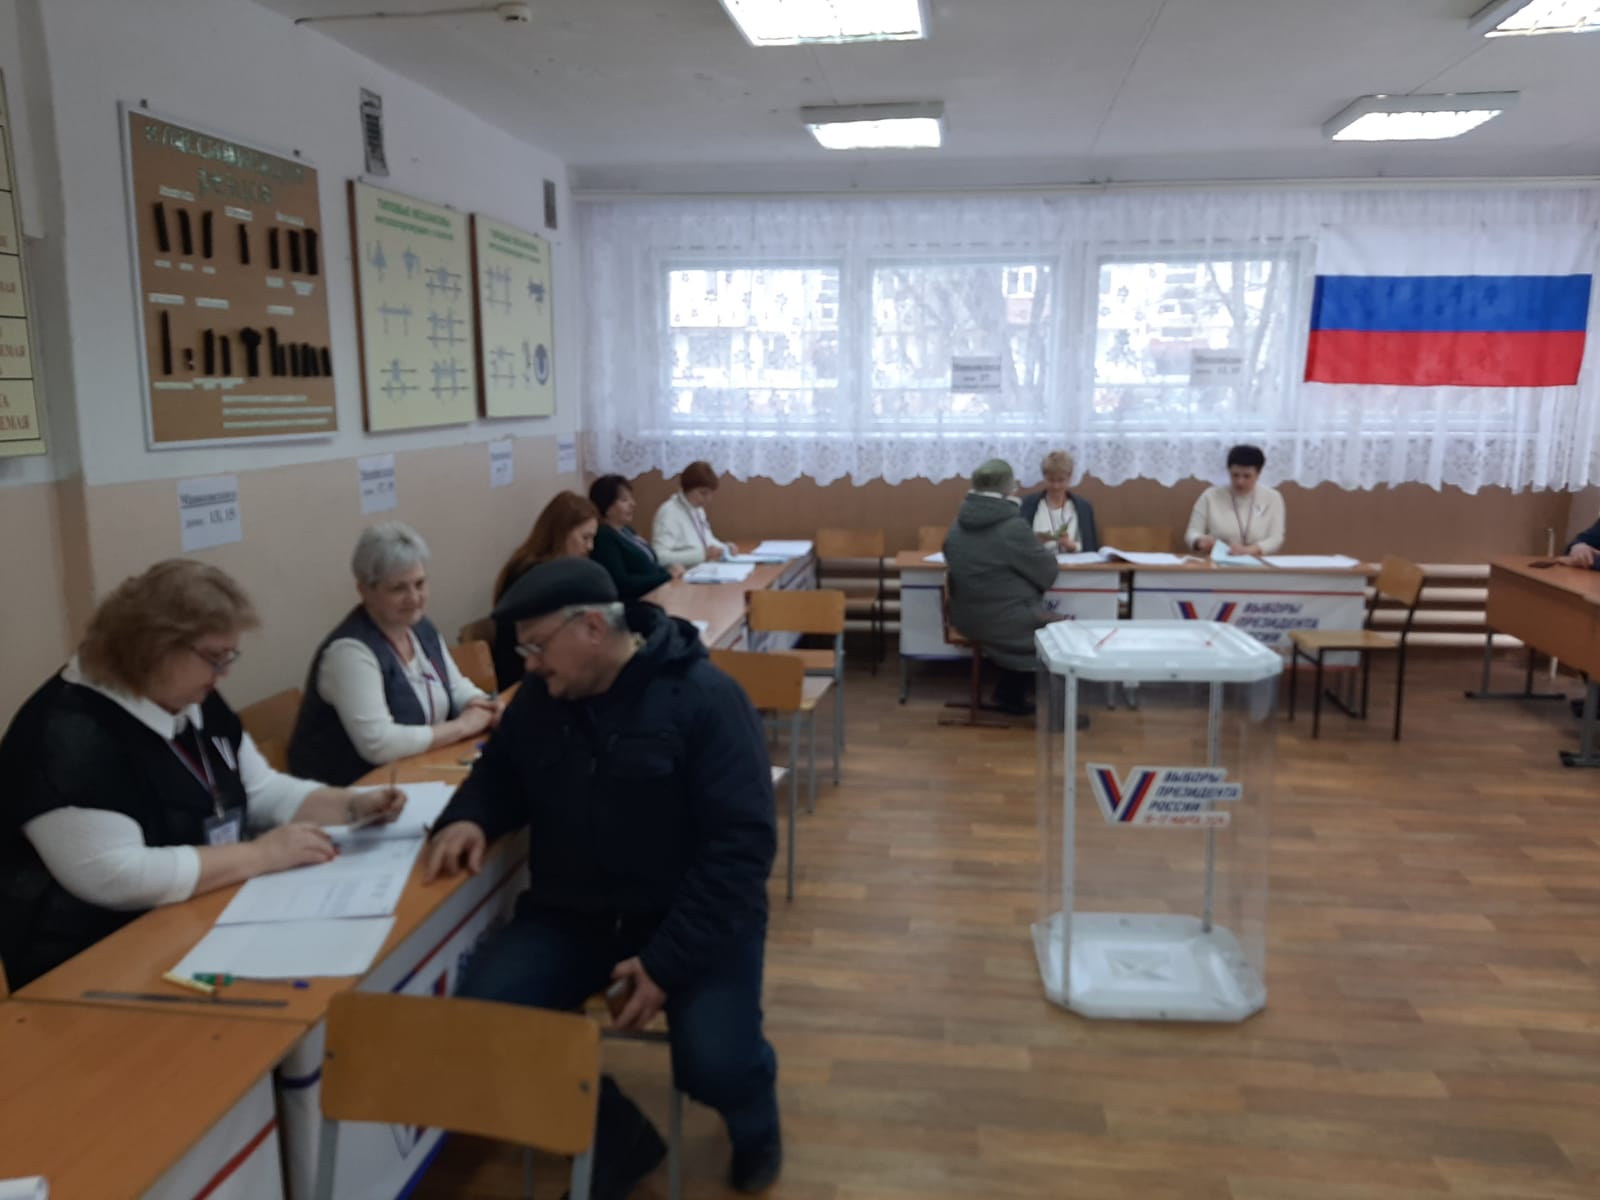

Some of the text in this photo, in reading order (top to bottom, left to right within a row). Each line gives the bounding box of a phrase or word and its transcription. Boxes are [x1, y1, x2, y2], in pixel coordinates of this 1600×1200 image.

[1163, 770, 1221, 783] ВЫБОРЫ
[1156, 785, 1238, 799] ПРЕЗИДЕНТА
[1148, 800, 1201, 812] РОССИИ
